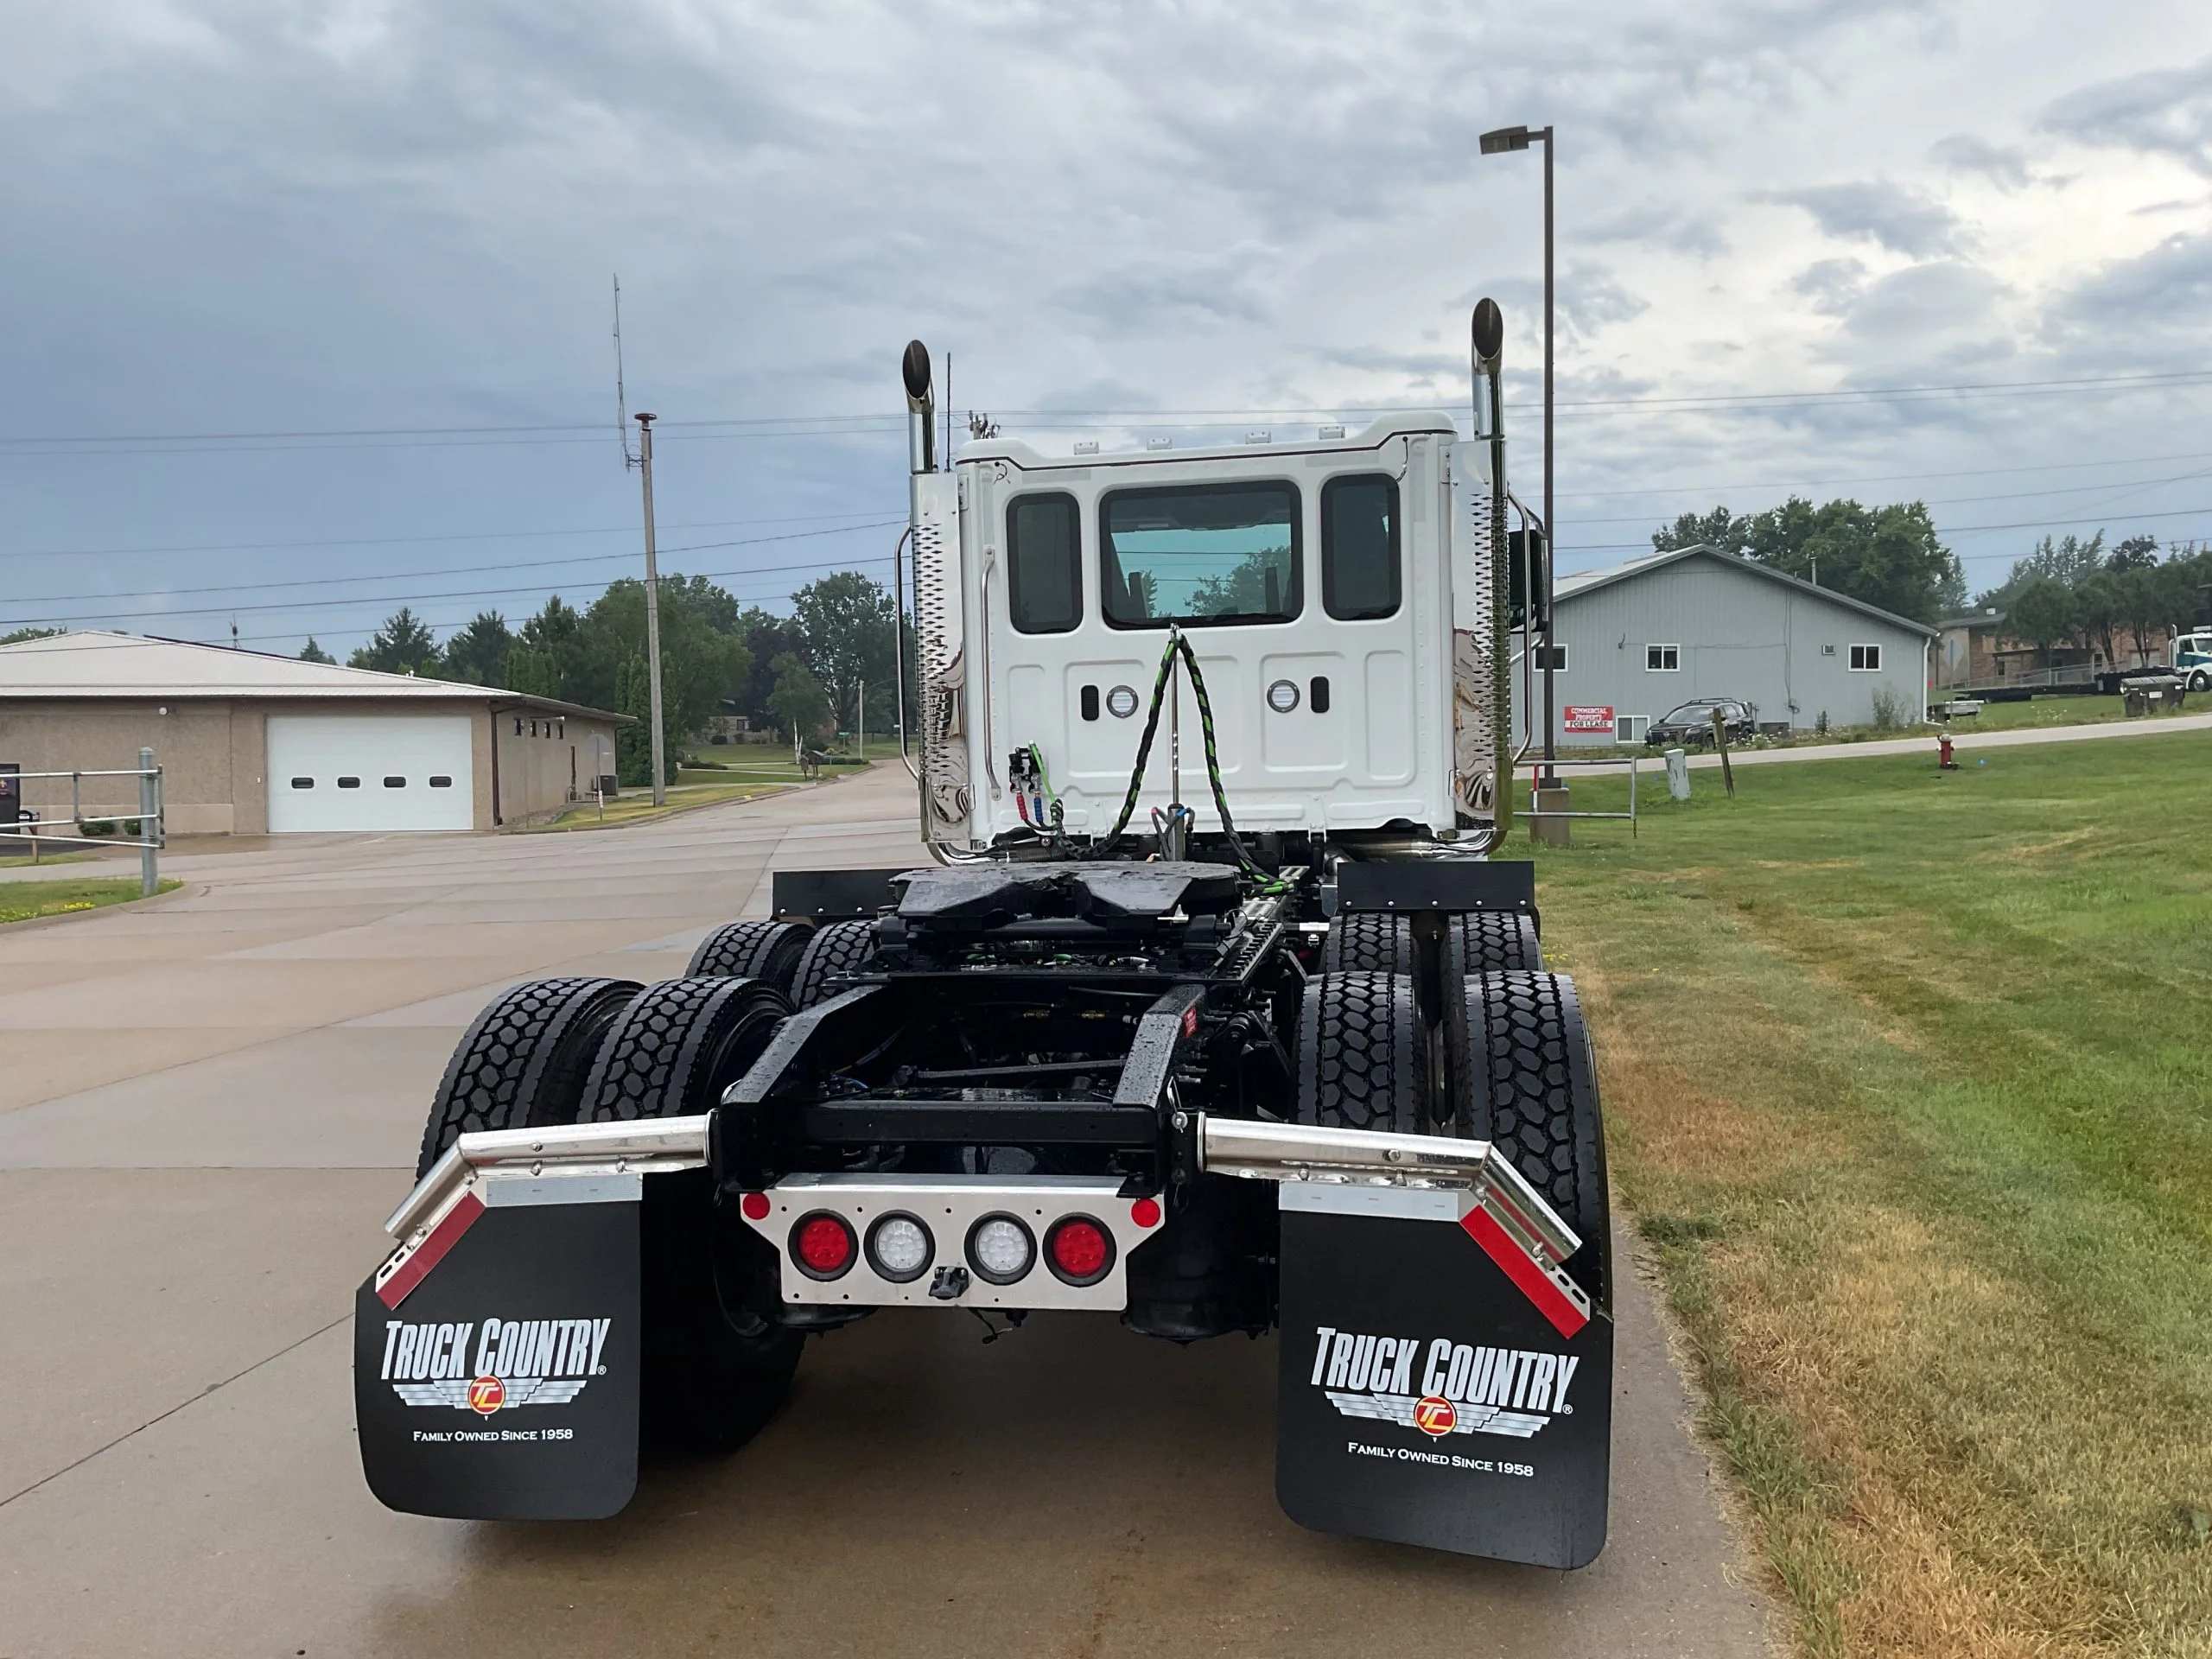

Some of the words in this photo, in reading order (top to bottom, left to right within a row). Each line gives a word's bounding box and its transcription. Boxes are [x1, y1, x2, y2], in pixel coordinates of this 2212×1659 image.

[381, 1320, 474, 1379] TRUCK
[1311, 1326, 1419, 1395] TRUCK
[413, 1431, 452, 1442] FAMILY
[454, 1431, 499, 1441] OWNED
[501, 1430, 537, 1440] SINCE
[541, 1429, 573, 1440] 1958
[1348, 1442, 1395, 1459] FAMILY
[1398, 1448, 1449, 1465] OWNED
[1452, 1455, 1493, 1471] SINCE
[1497, 1461, 1534, 1478] 1958
